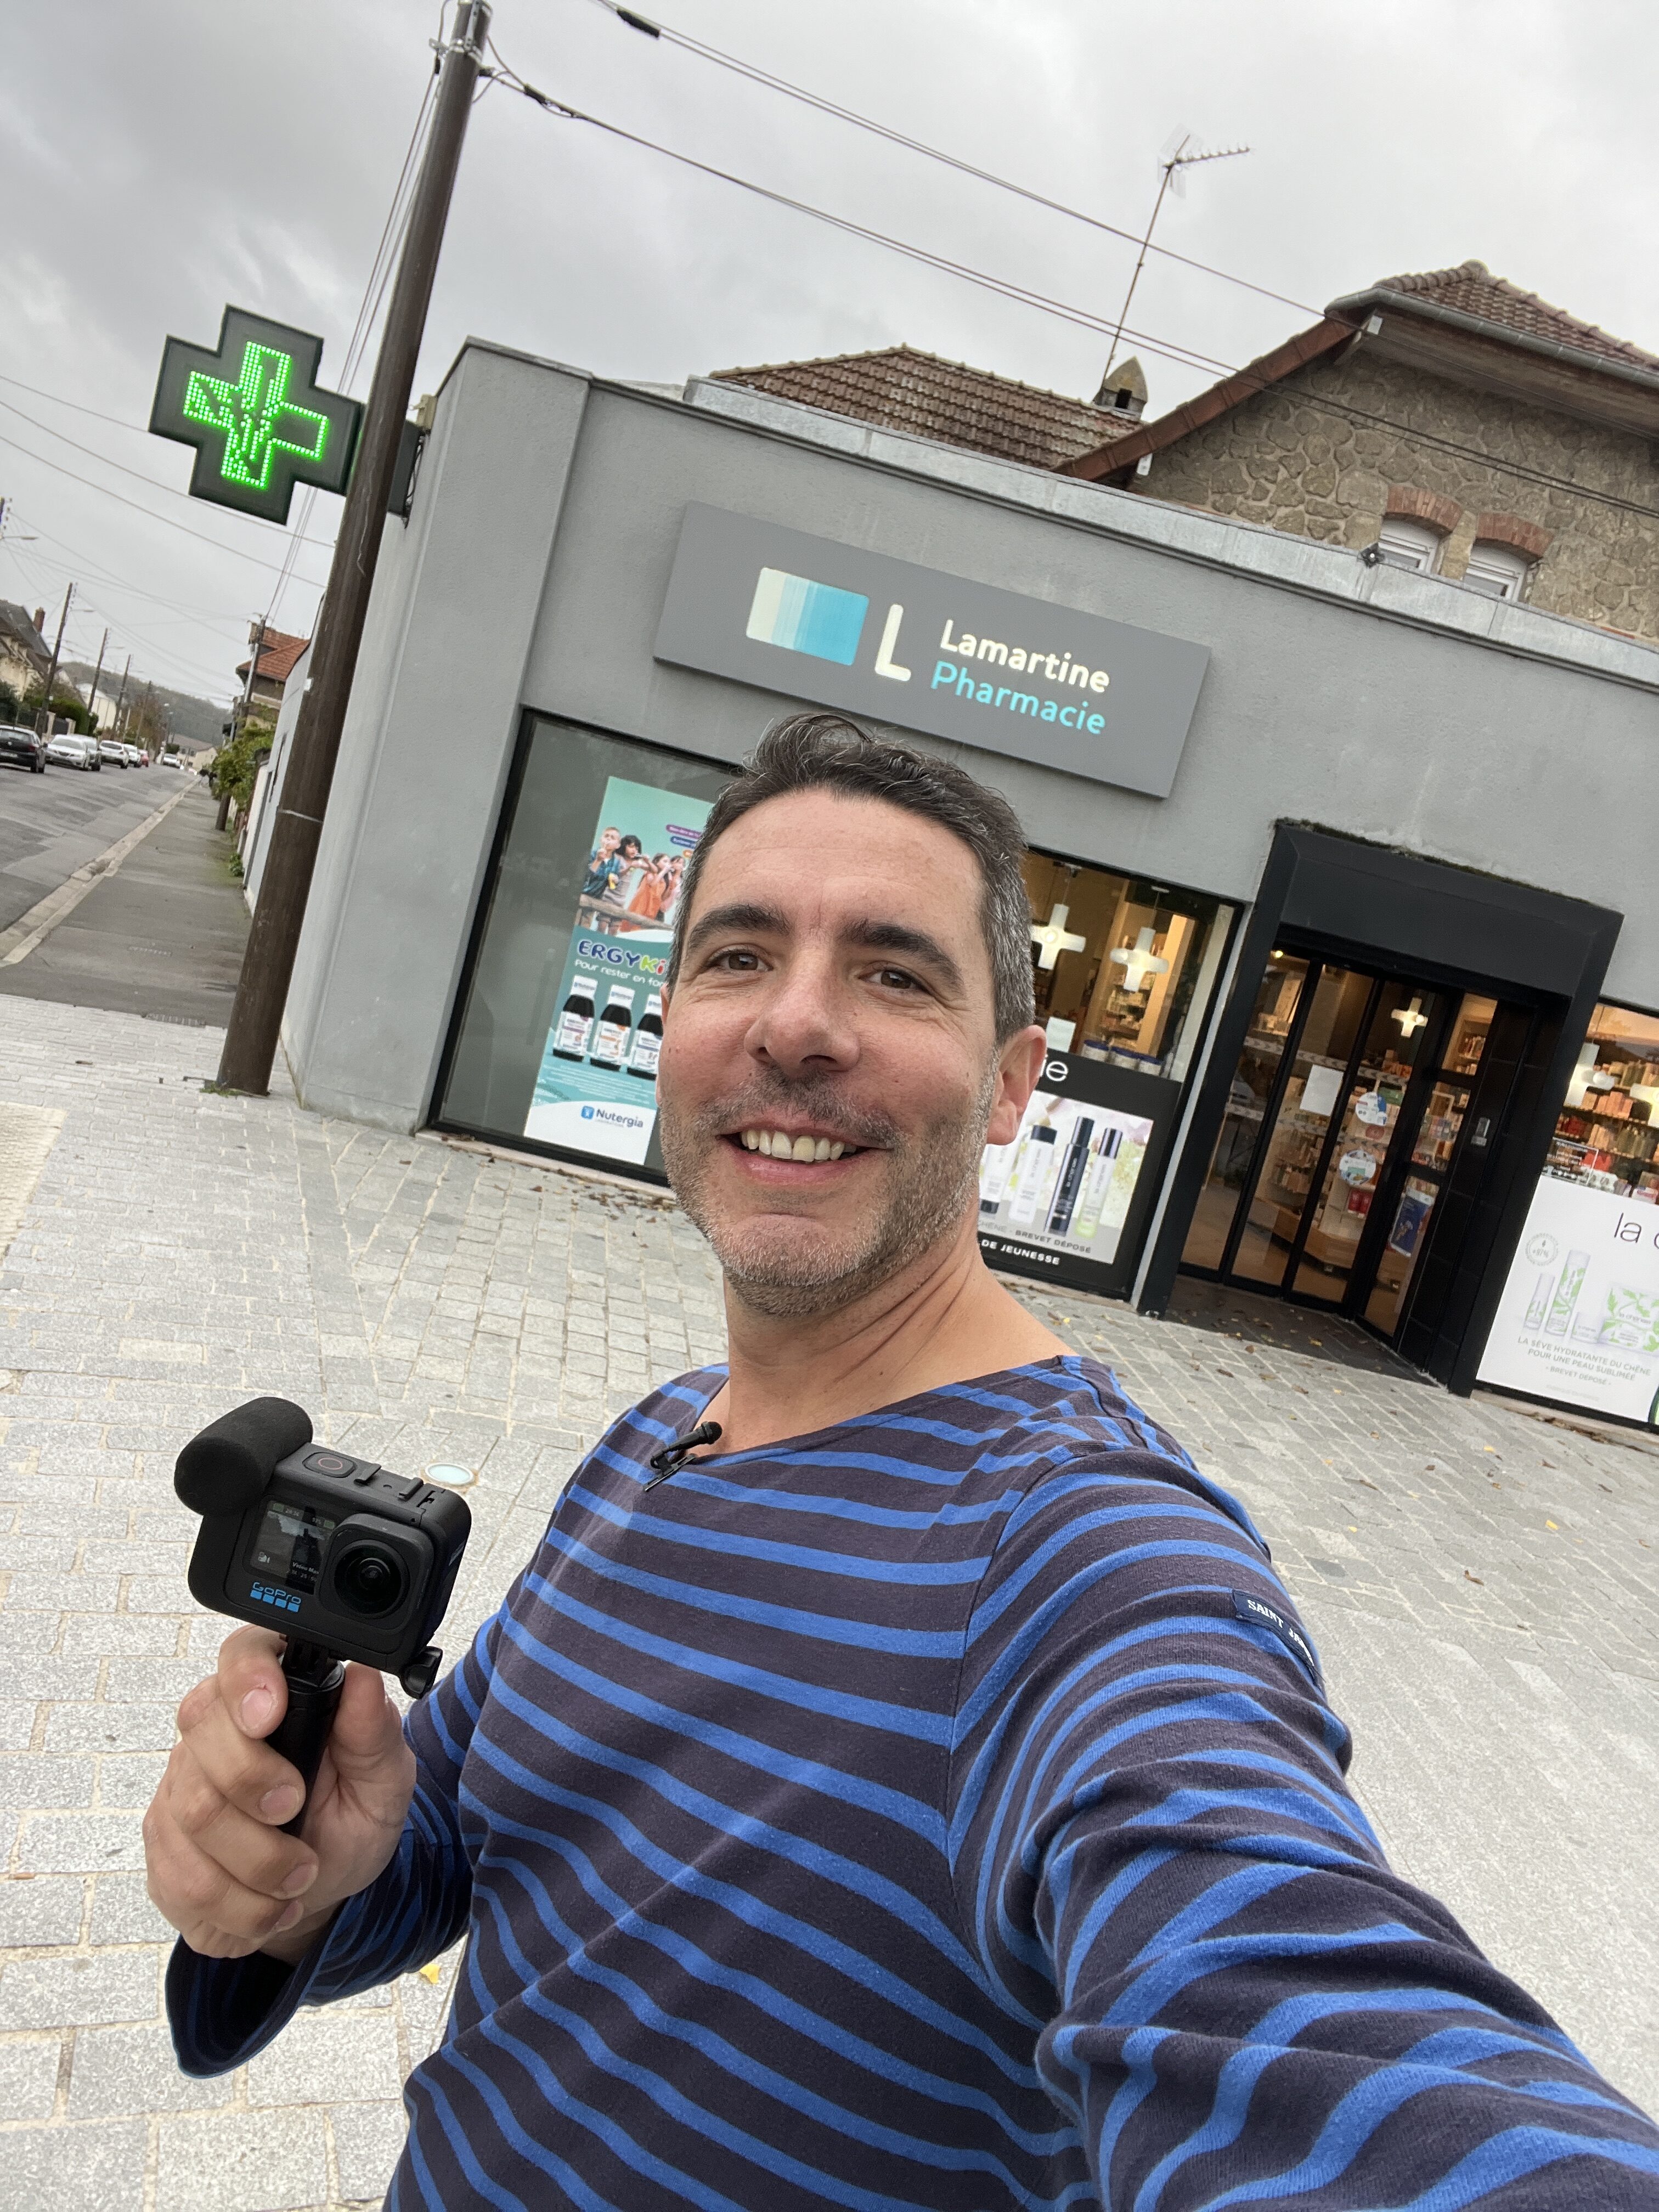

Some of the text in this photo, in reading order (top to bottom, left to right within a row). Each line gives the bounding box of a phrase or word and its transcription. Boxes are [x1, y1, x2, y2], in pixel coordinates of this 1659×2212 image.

[940, 619, 1110, 693] Lamartine
[930, 660, 1105, 735] Pharmacie
[575, 959, 599, 971] Pour
[601, 967, 631, 979] rester
[596, 1109, 644, 1127] Nutergia
[1015, 1229, 1051, 1243] BREVET
[1054, 1239, 1091, 1253] DÉPOSÉ
[1614, 1212, 1642, 1243] la
[981, 1239, 1060, 1265] DE JEUNESSE
[1518, 1336, 1528, 1344] LA
[1554, 1346, 1608, 1365] HYDRATANTE
[1610, 1360, 1622, 1368] DU
[1528, 1348, 1635, 1381] POUR UNE PEAU SUBLIMÉE
[1550, 1366, 1607, 1385] BREVET DÉPOSÉ
[252, 1582, 301, 1604] GoPro
[1248, 1599, 1284, 1628] SAINT
